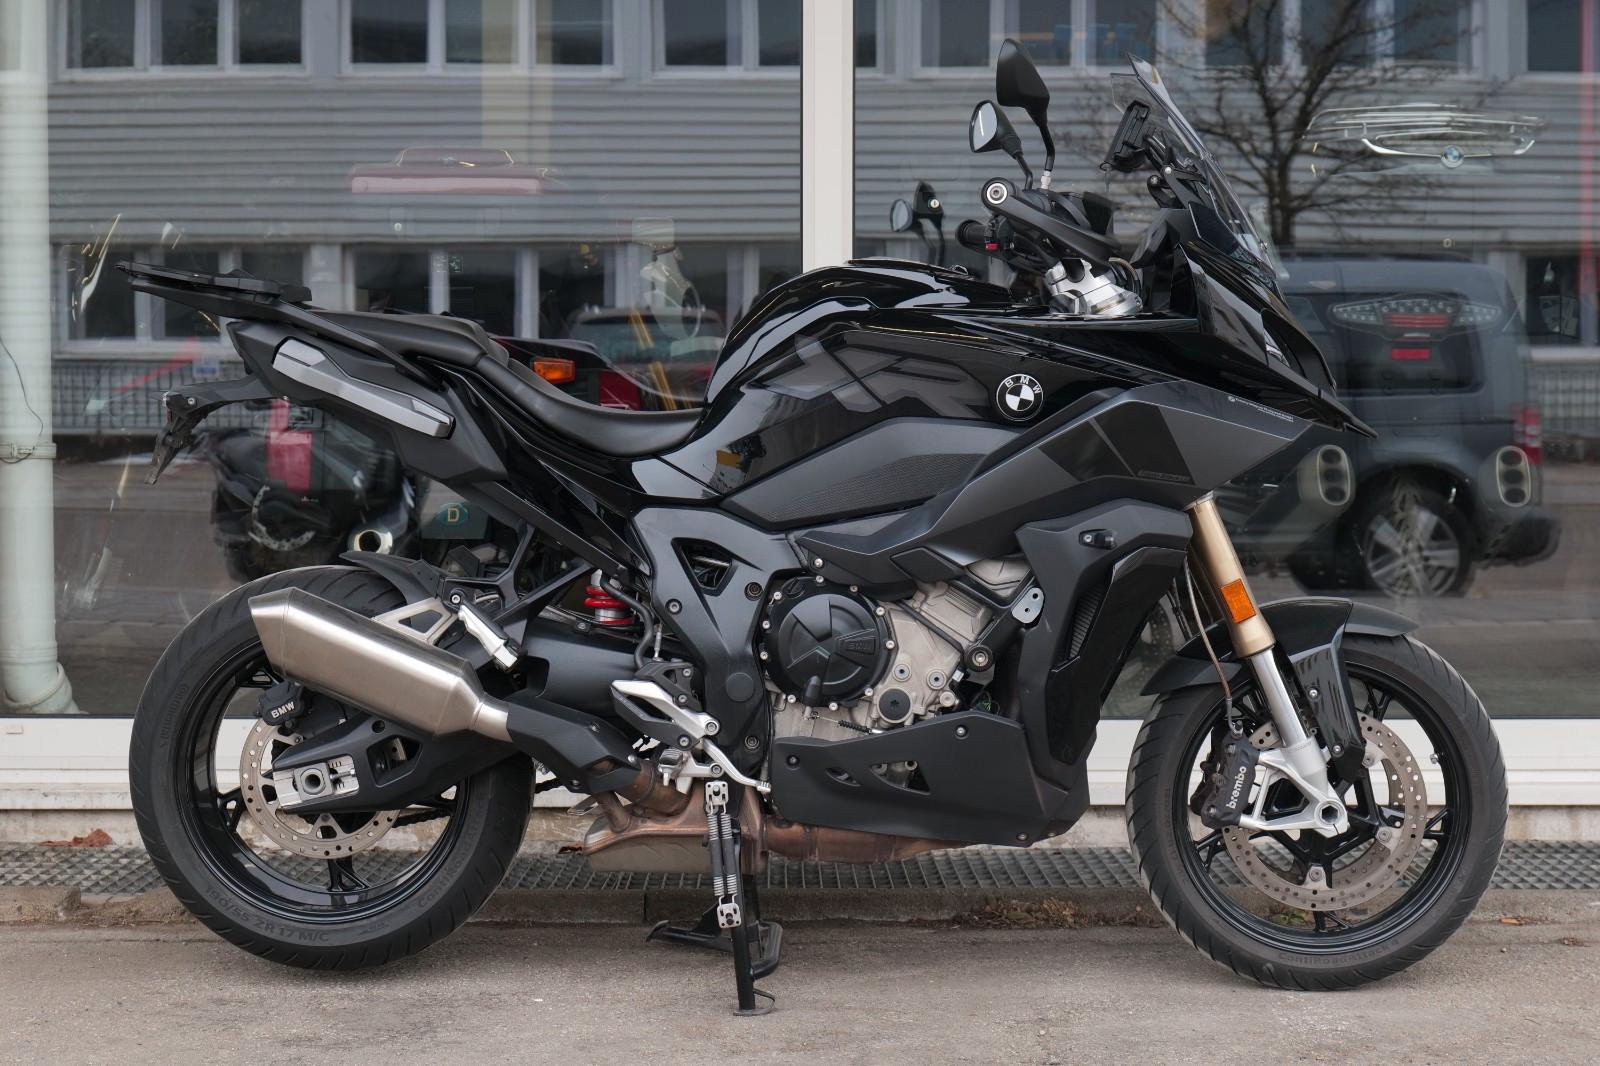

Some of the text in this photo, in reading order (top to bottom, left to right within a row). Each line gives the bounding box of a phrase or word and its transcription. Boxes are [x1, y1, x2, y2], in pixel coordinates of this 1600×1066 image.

[447, 507, 460, 522] D
[271, 701, 295, 718] BMW
[1226, 766, 1247, 809] brembo
